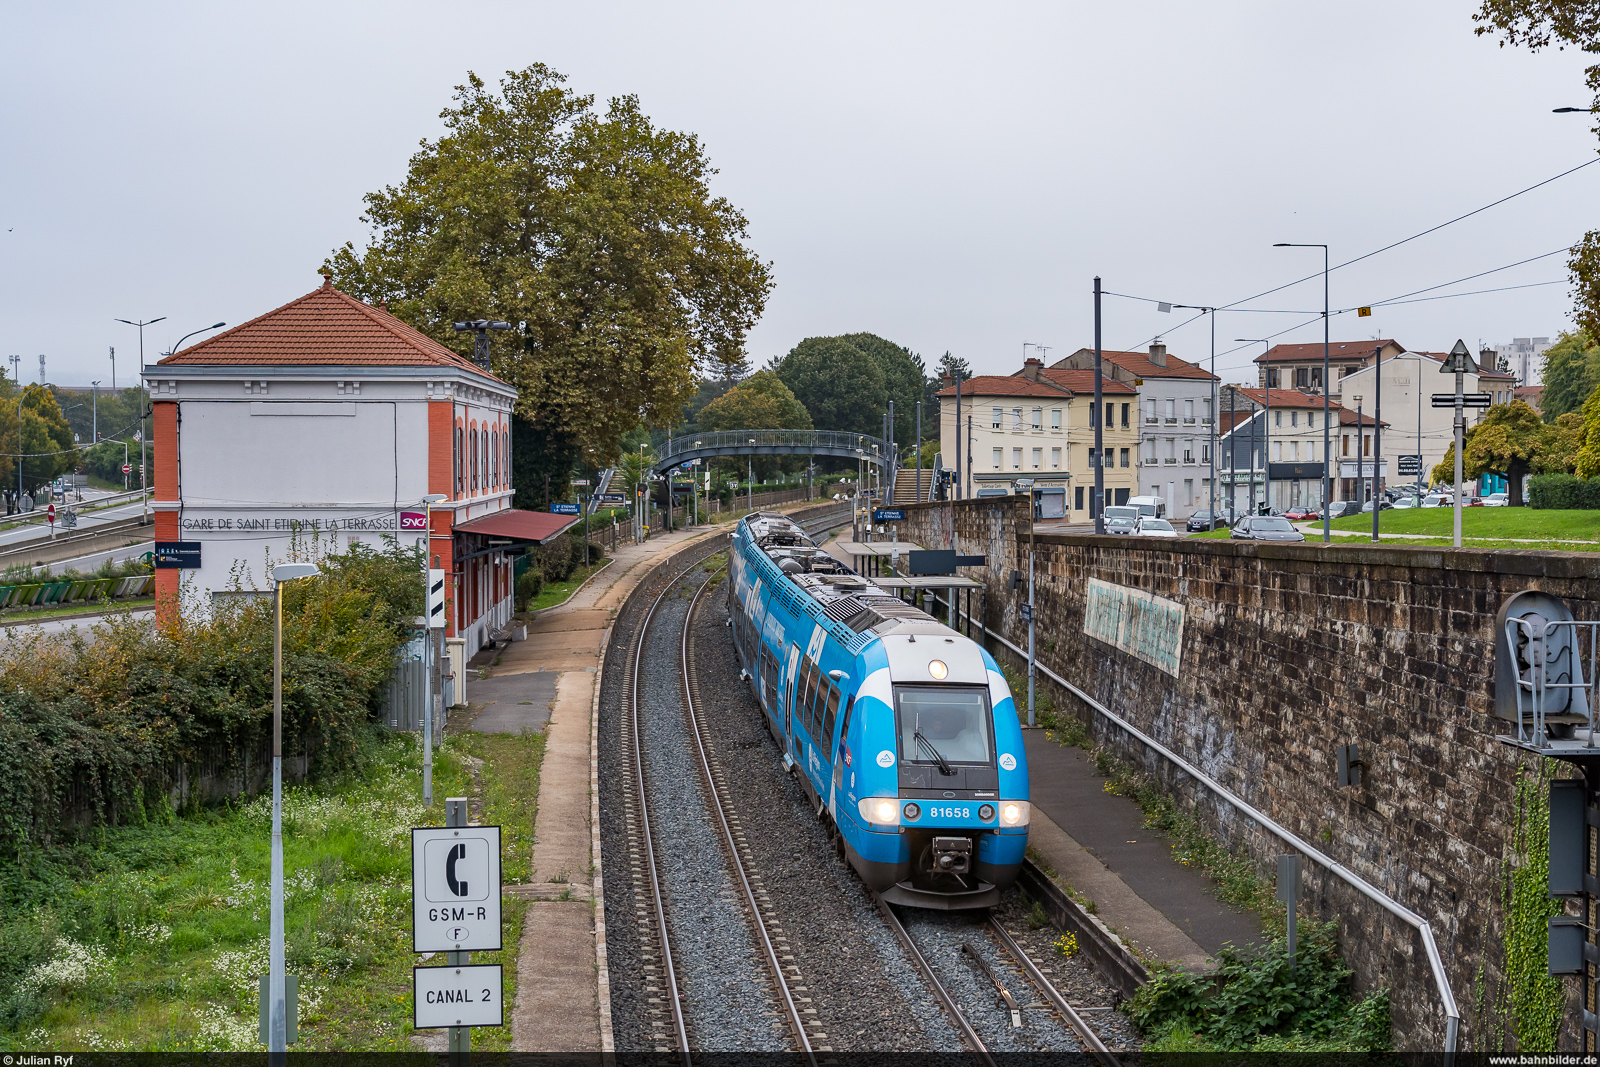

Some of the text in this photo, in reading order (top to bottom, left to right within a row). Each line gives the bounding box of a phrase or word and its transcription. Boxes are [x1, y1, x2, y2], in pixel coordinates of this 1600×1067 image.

[182, 518, 395, 530] GARE DE SAINT ETIENNE LA TERRASSE
[930, 807, 970, 818] 81658
[429, 907, 486, 921] GSM-R
[454, 928, 461, 940] F
[426, 988, 491, 1004] CANAL 2
